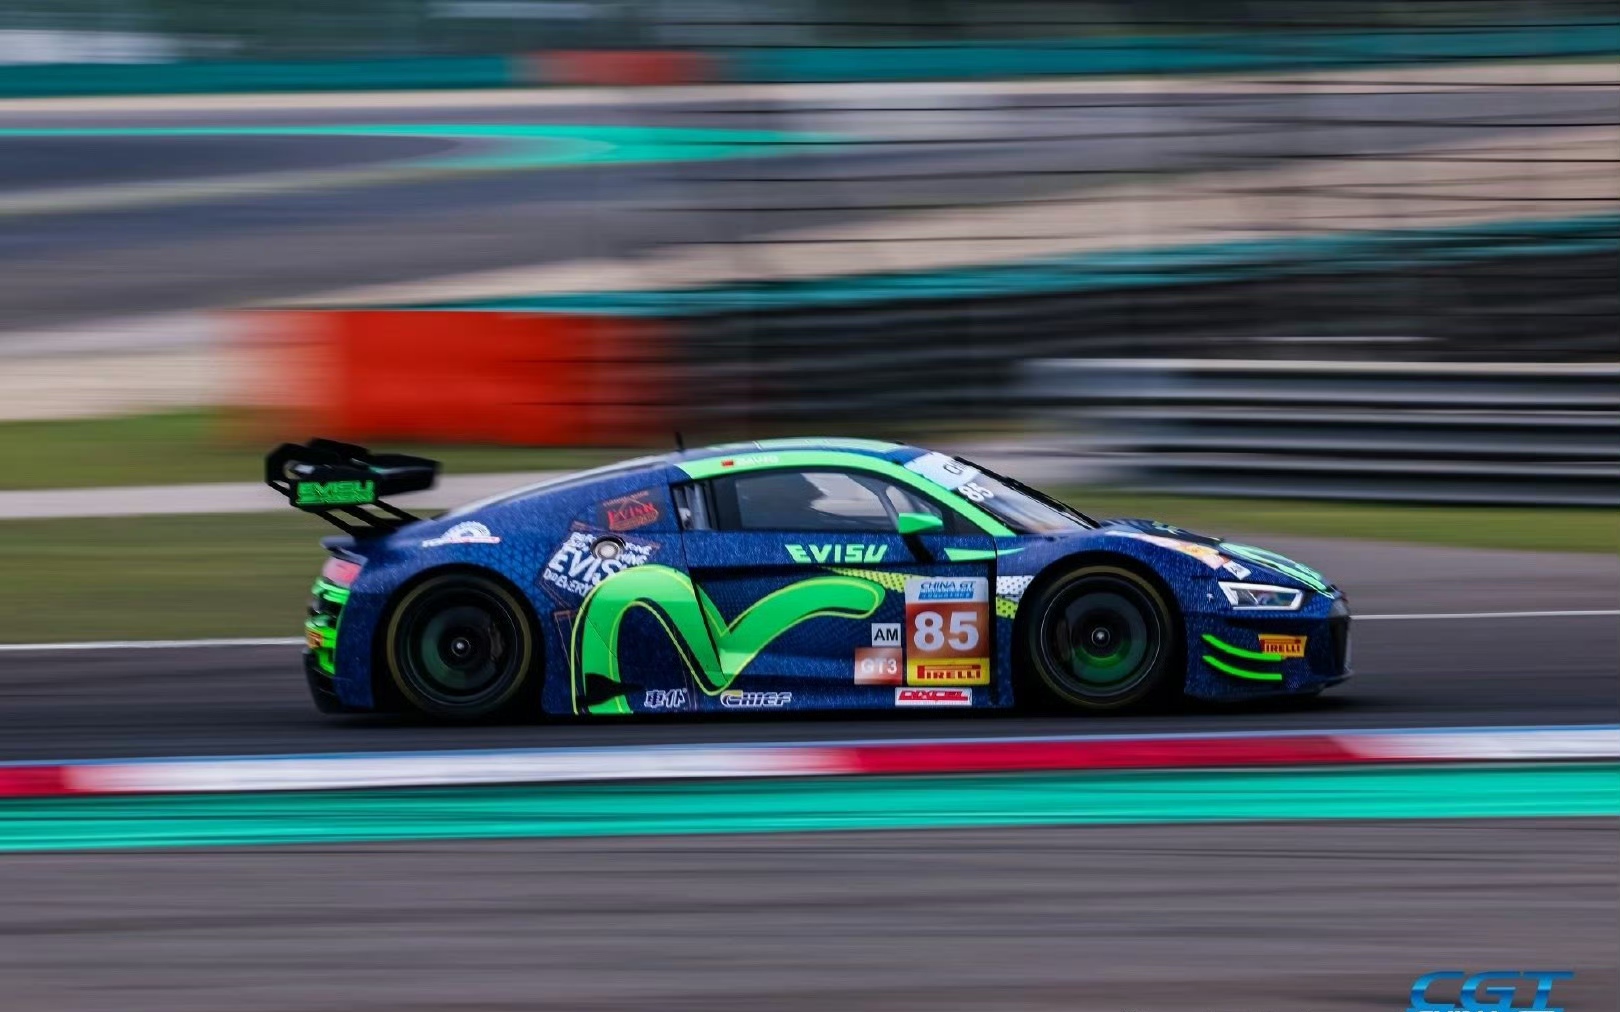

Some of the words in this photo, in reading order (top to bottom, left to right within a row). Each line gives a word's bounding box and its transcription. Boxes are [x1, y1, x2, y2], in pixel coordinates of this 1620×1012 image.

[958, 482, 994, 502] 85
[785, 544, 888, 563] EVISU
[920, 581, 956, 590] CHINA
[874, 628, 899, 641] AM
[913, 611, 979, 650] 85
[861, 658, 897, 675] GT3
[917, 664, 981, 679] PIRELLI
[720, 690, 792, 707] CHIEF
